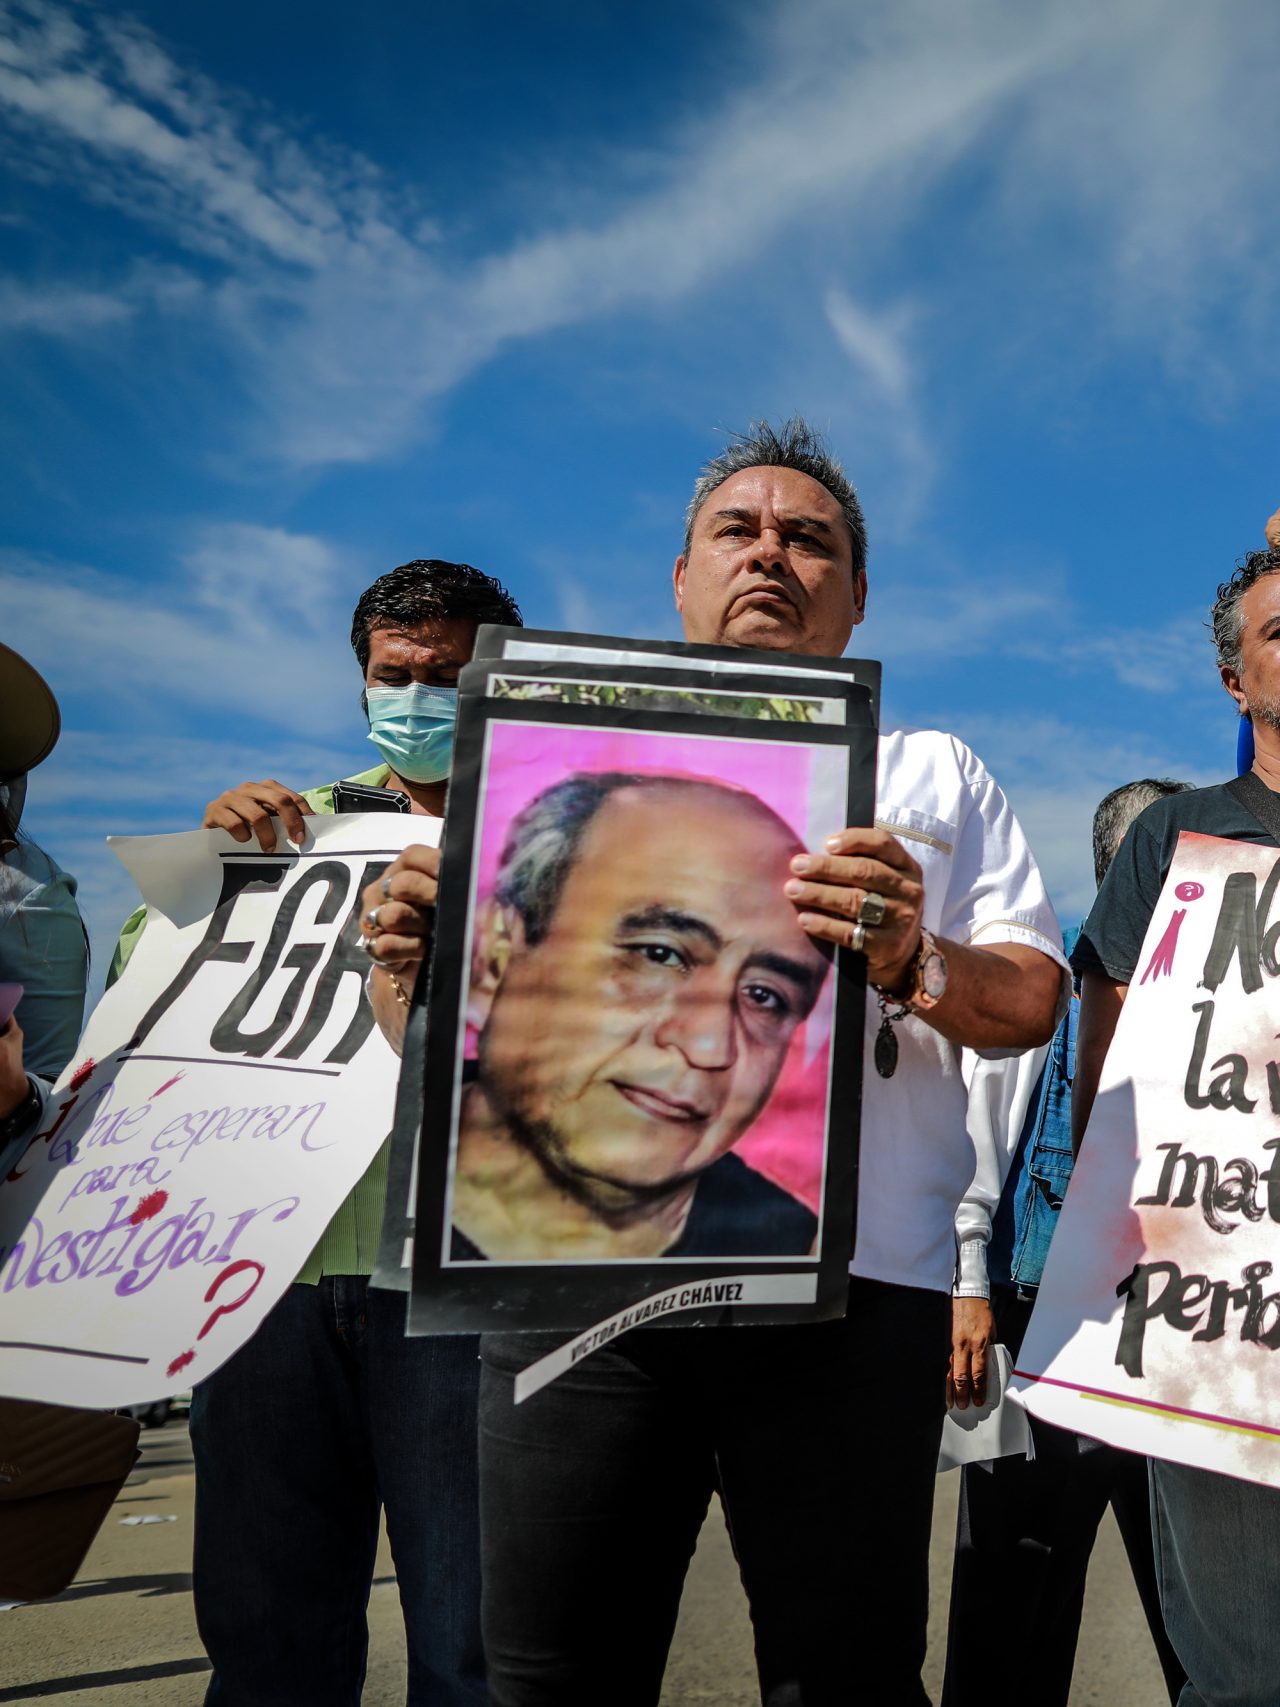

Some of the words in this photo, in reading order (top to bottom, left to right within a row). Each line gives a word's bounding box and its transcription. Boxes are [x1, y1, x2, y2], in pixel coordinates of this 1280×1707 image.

[1183, 1001, 1259, 1114] la
[150, 1101, 338, 1162] esperan
[58, 1156, 172, 1213] para
[679, 1283, 743, 1307] CHÁVEZ
